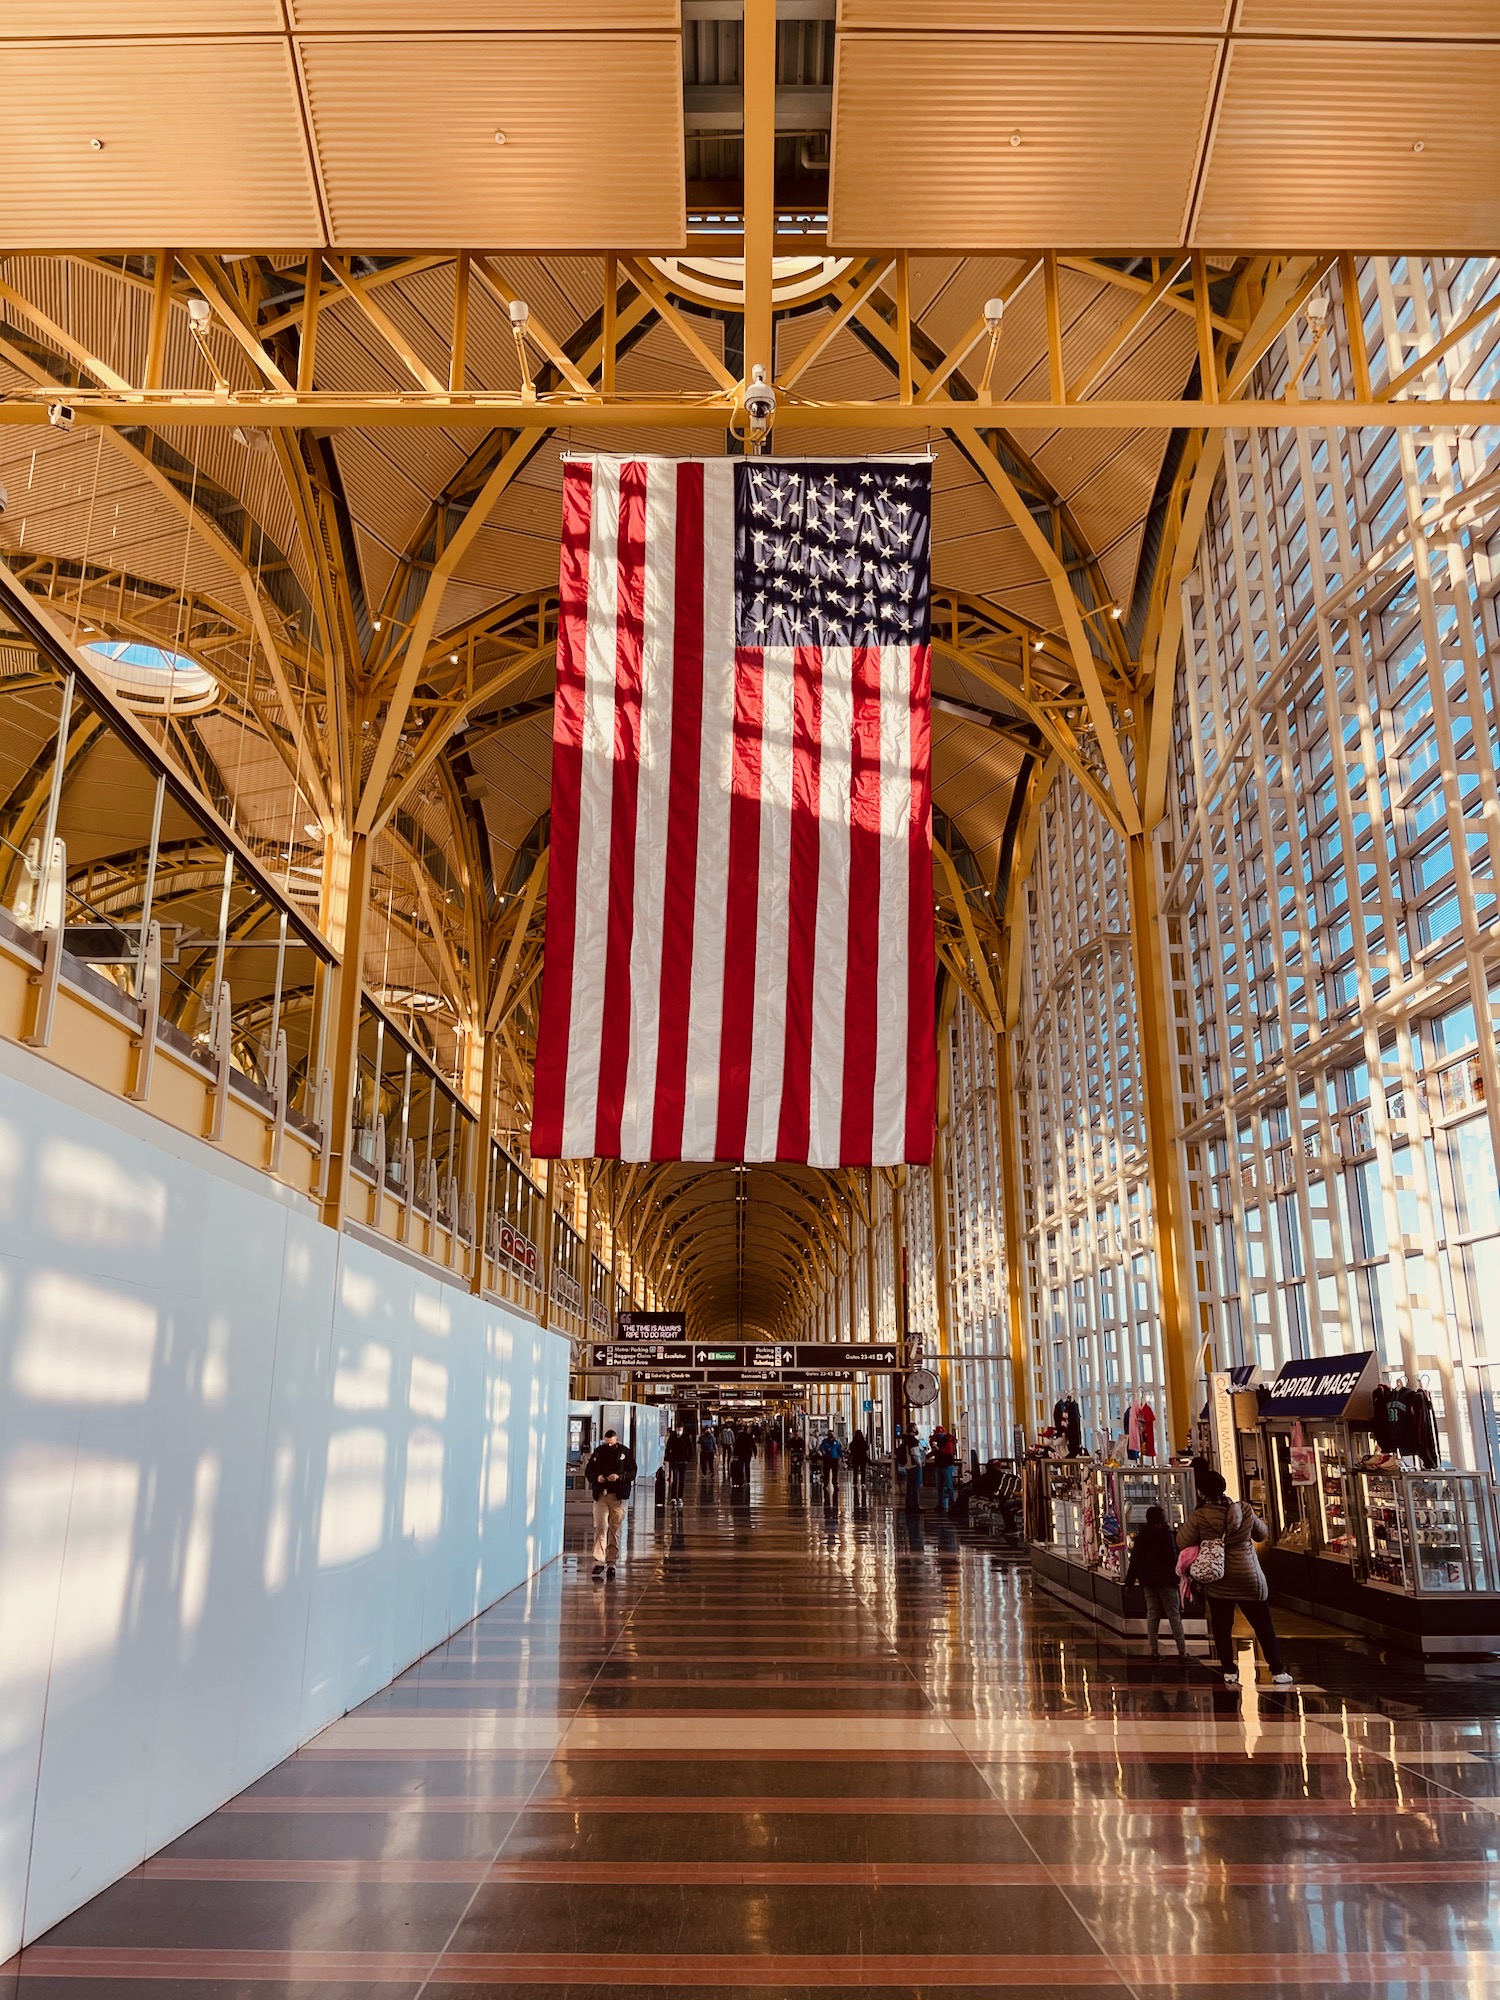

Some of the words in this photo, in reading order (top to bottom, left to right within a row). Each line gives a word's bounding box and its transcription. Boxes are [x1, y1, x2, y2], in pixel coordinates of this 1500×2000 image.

[1216, 1377, 1228, 1423] CAPITAL
[1271, 1376, 1314, 1398] CAPITAL
[1315, 1372, 1360, 1396] IMAGE
[1221, 1428, 1233, 1467] IMAGE
